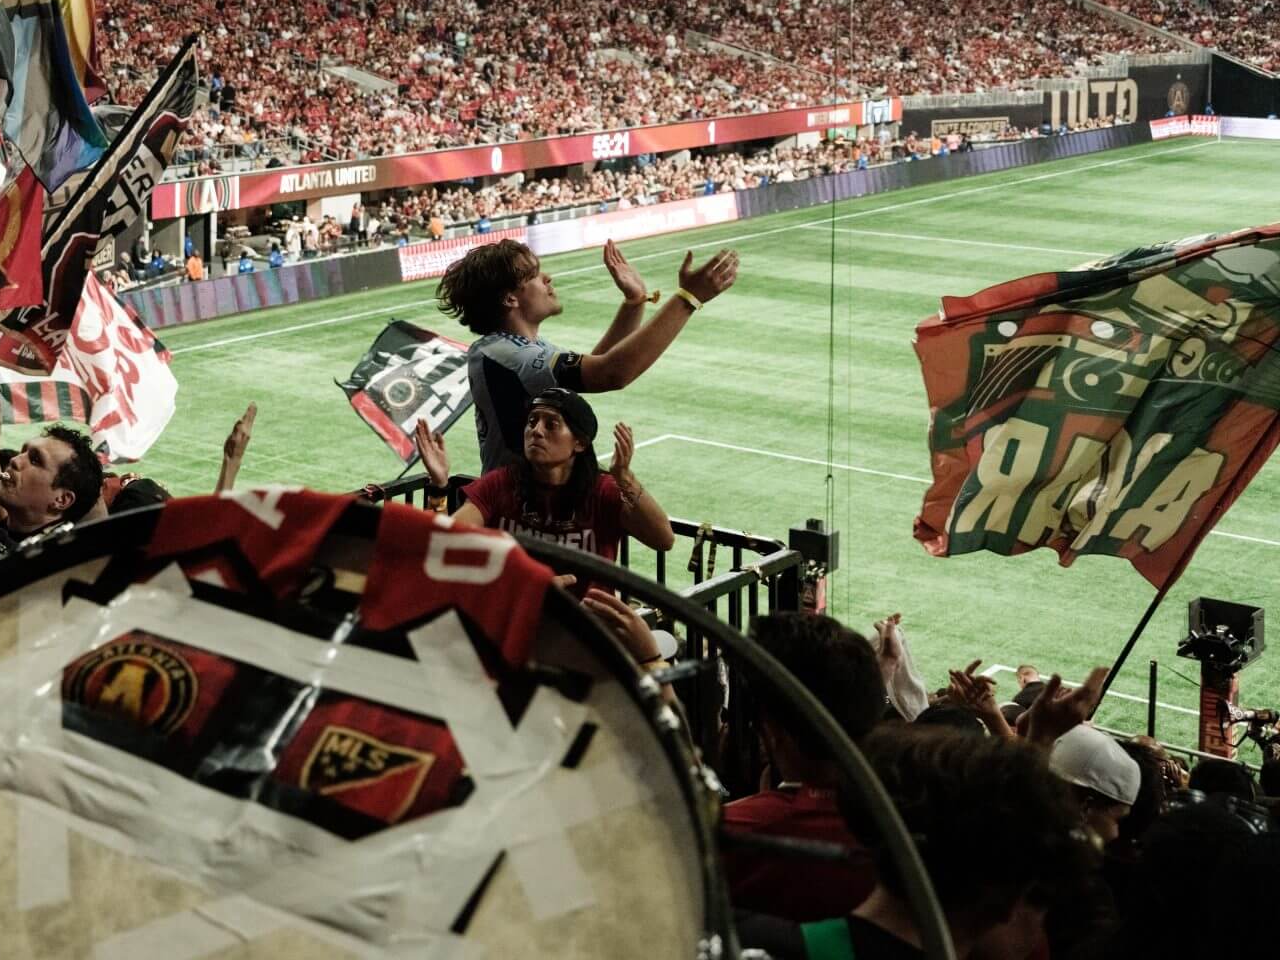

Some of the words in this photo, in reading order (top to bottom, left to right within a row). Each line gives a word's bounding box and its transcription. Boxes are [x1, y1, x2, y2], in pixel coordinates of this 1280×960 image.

[592, 132, 630, 159] 55:21
[708, 121, 716, 144] 1
[490, 147, 503, 173] 0
[279, 171, 333, 194] ATLANTA
[335, 165, 377, 186] UNITED
[324, 732, 390, 771] MLS
